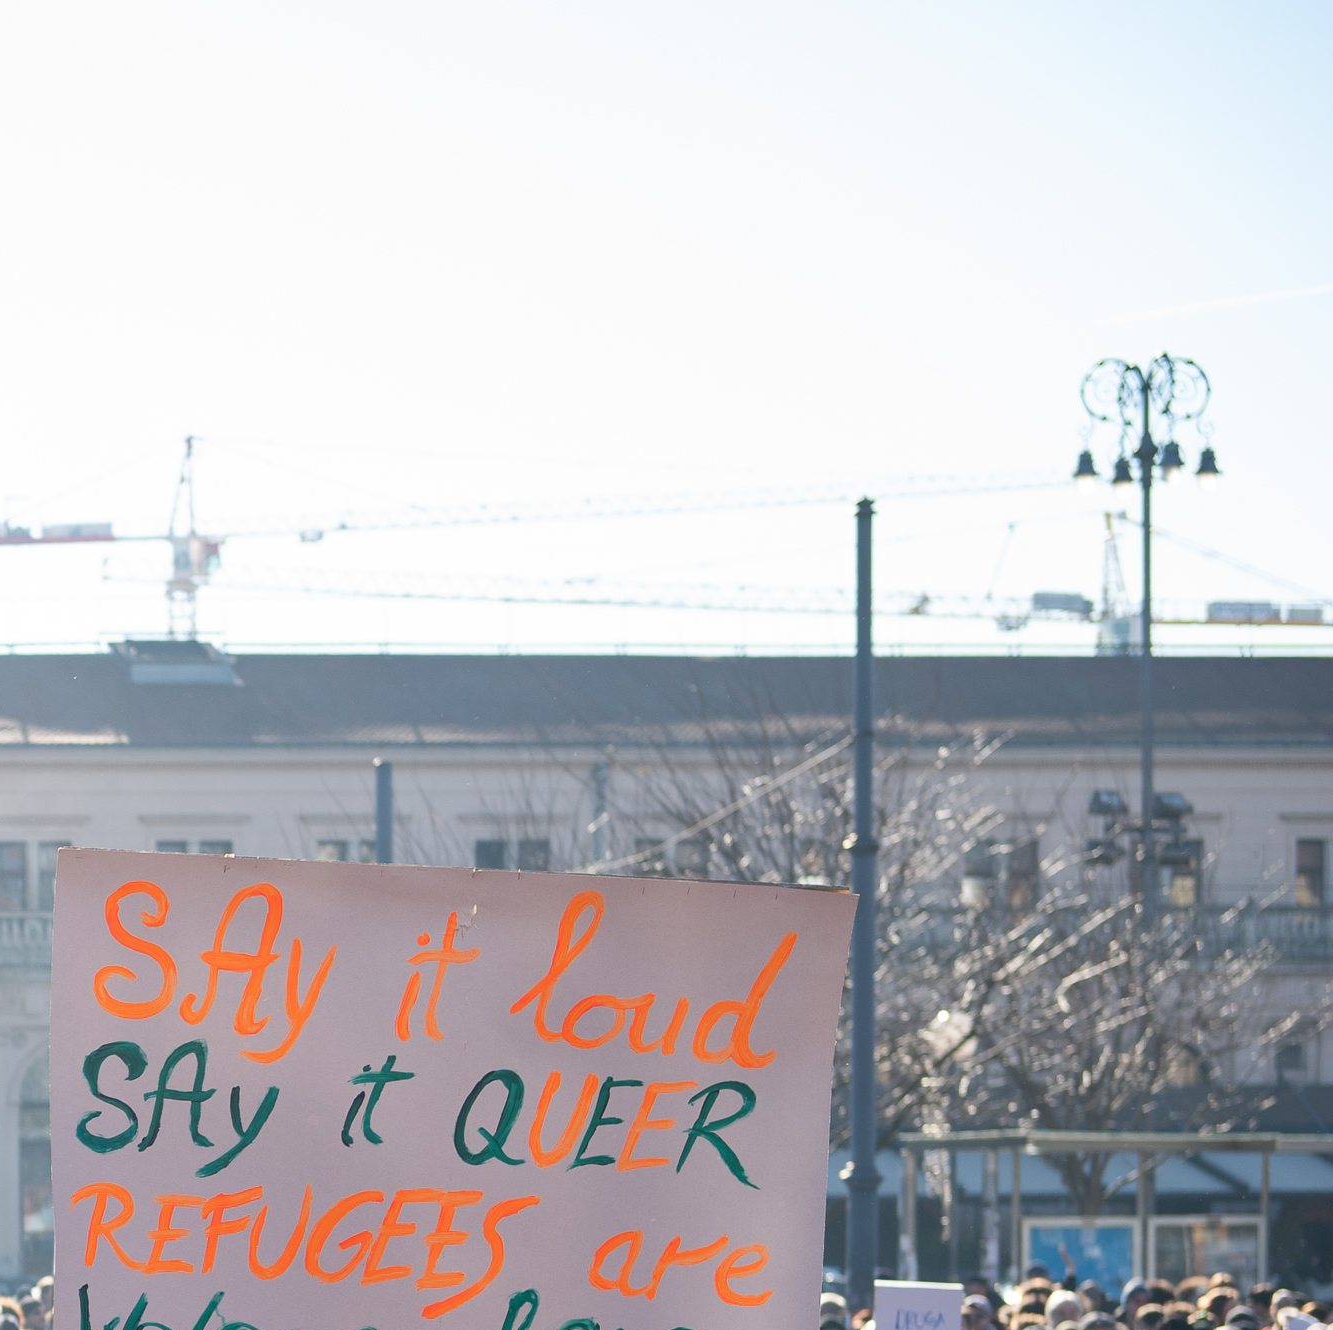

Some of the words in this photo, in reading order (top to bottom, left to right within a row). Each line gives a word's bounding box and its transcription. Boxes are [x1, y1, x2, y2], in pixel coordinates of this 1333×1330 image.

[392, 910, 481, 1042] it
[509, 890, 799, 1070] loud
[341, 1054, 416, 1147] it
[452, 1069, 761, 1191] QUEER
[68, 1182, 541, 1321] REFUGEES
[586, 1229, 776, 1308] are
